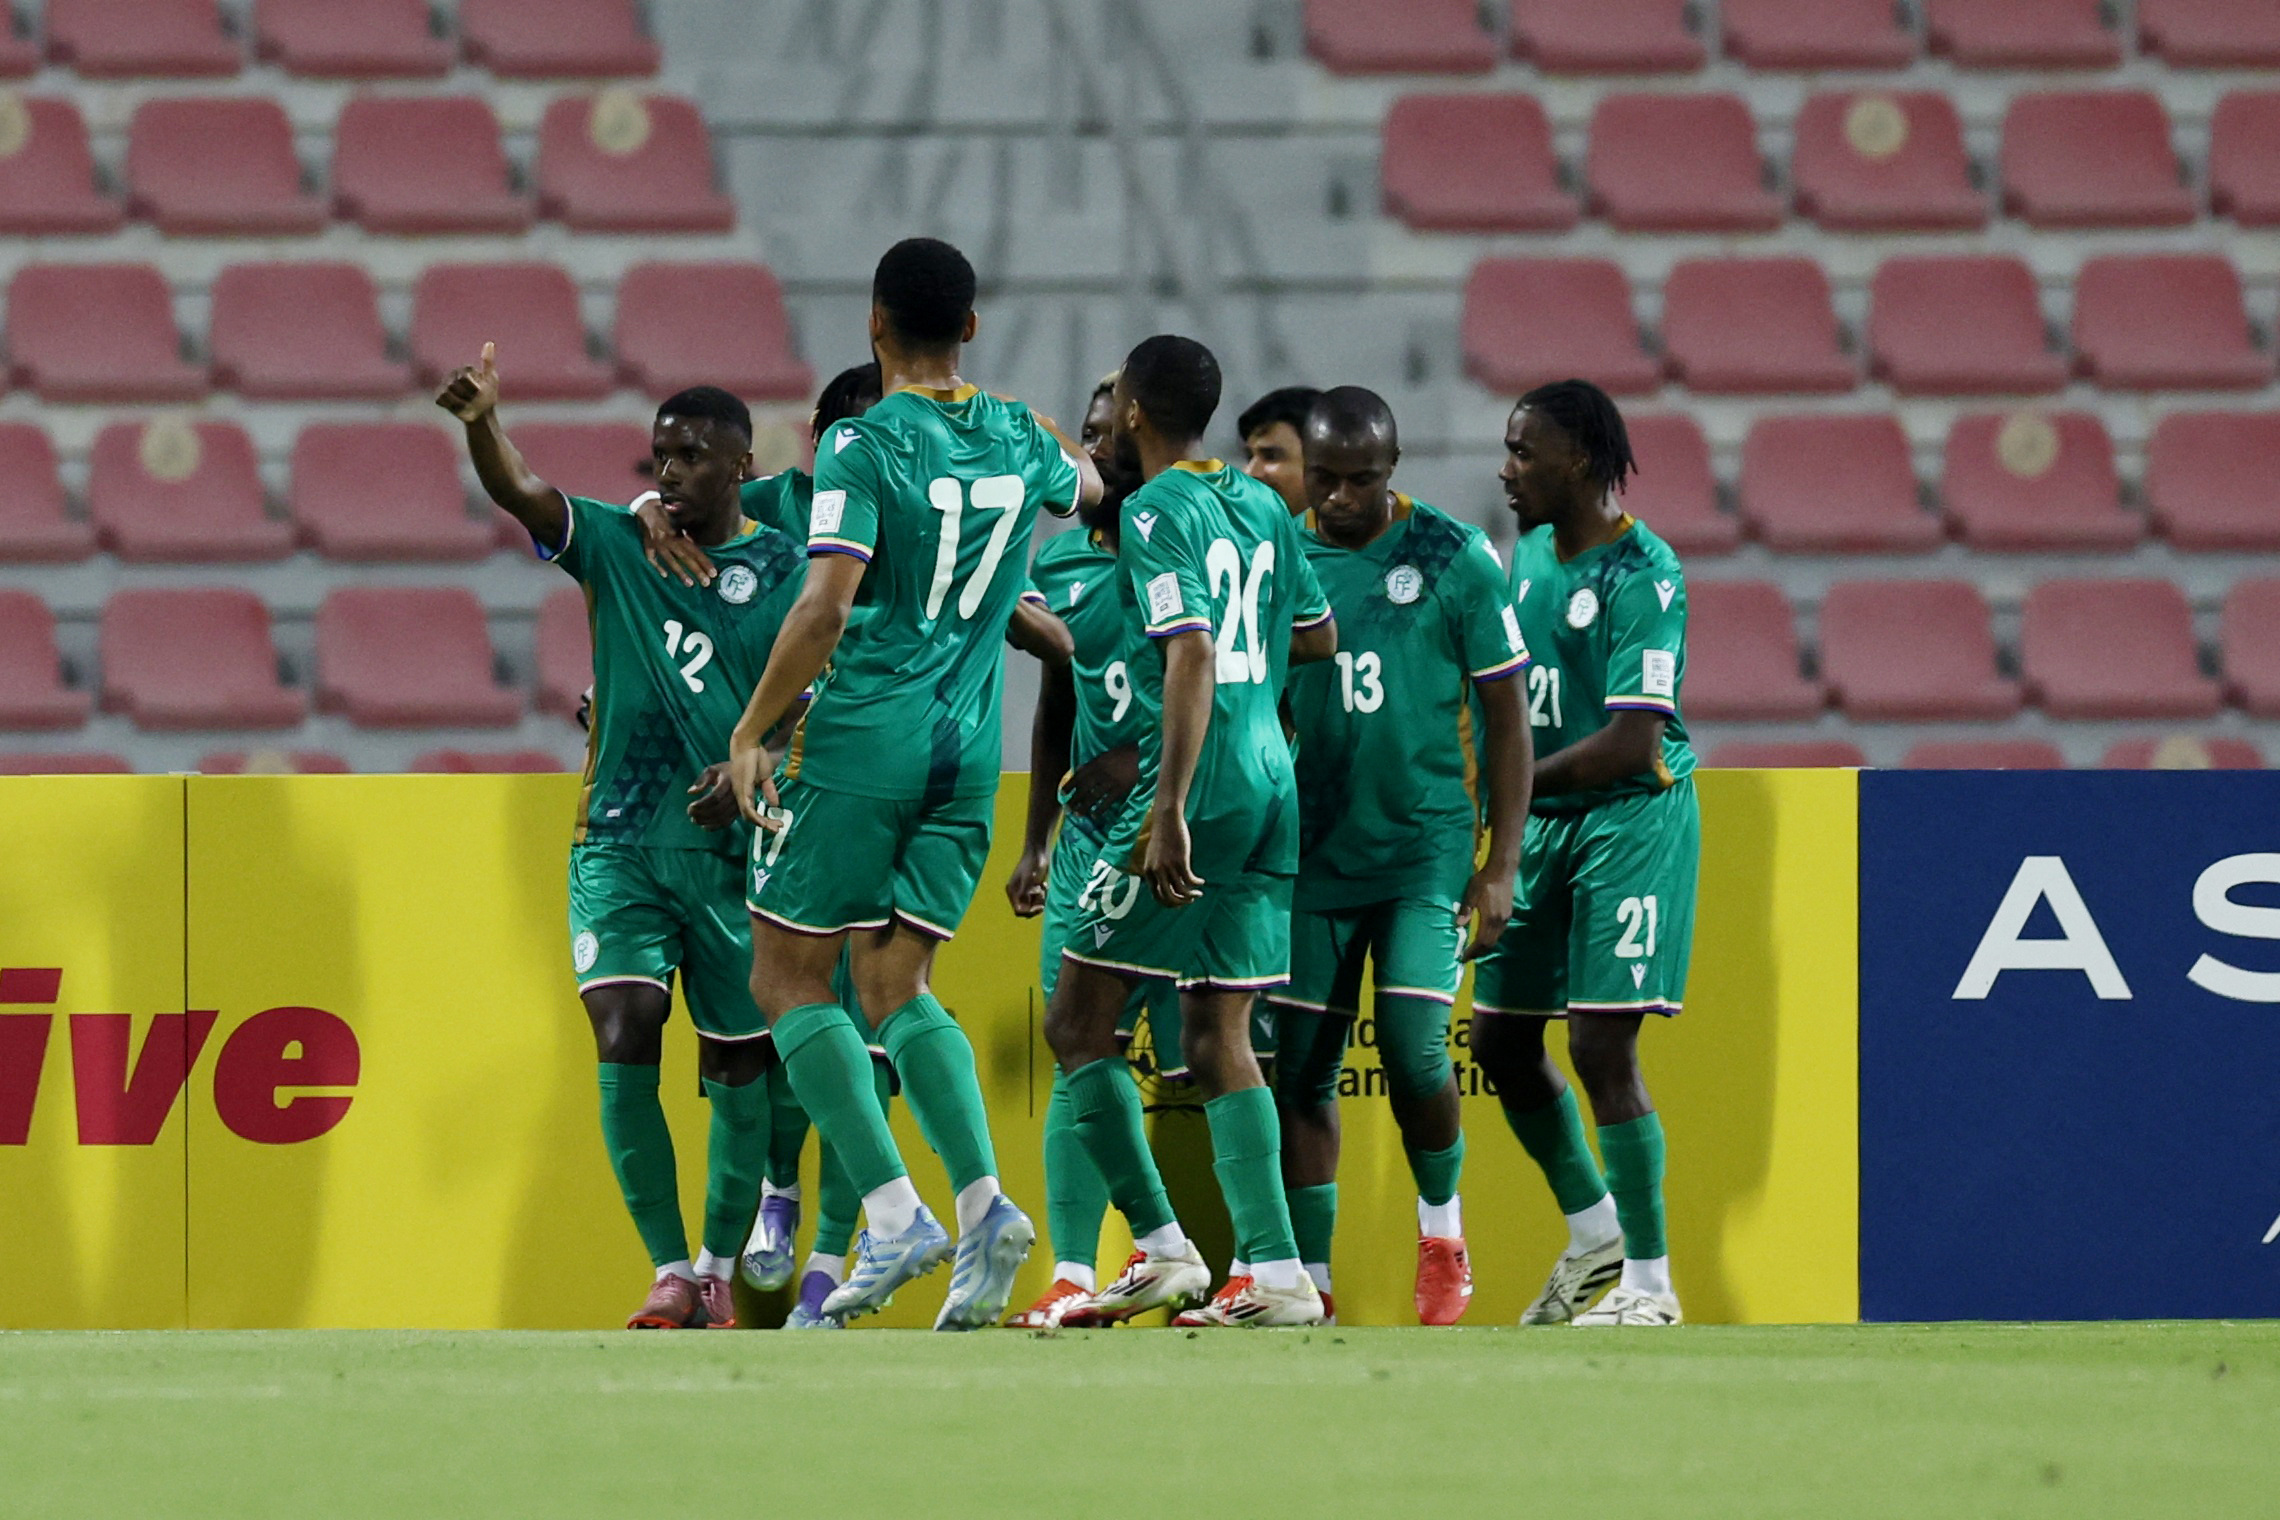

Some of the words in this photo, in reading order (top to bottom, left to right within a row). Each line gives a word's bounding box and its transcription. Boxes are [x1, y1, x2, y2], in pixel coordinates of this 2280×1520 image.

[925, 474, 1025, 620] 17
[1206, 538, 1275, 684] 20
[662, 619, 714, 693] 12
[1335, 651, 1384, 713] 13
[1105, 661, 1132, 722] 9
[1529, 665, 1562, 728] 21
[1615, 895, 1657, 958] 21
[0, 968, 361, 1145] ive
